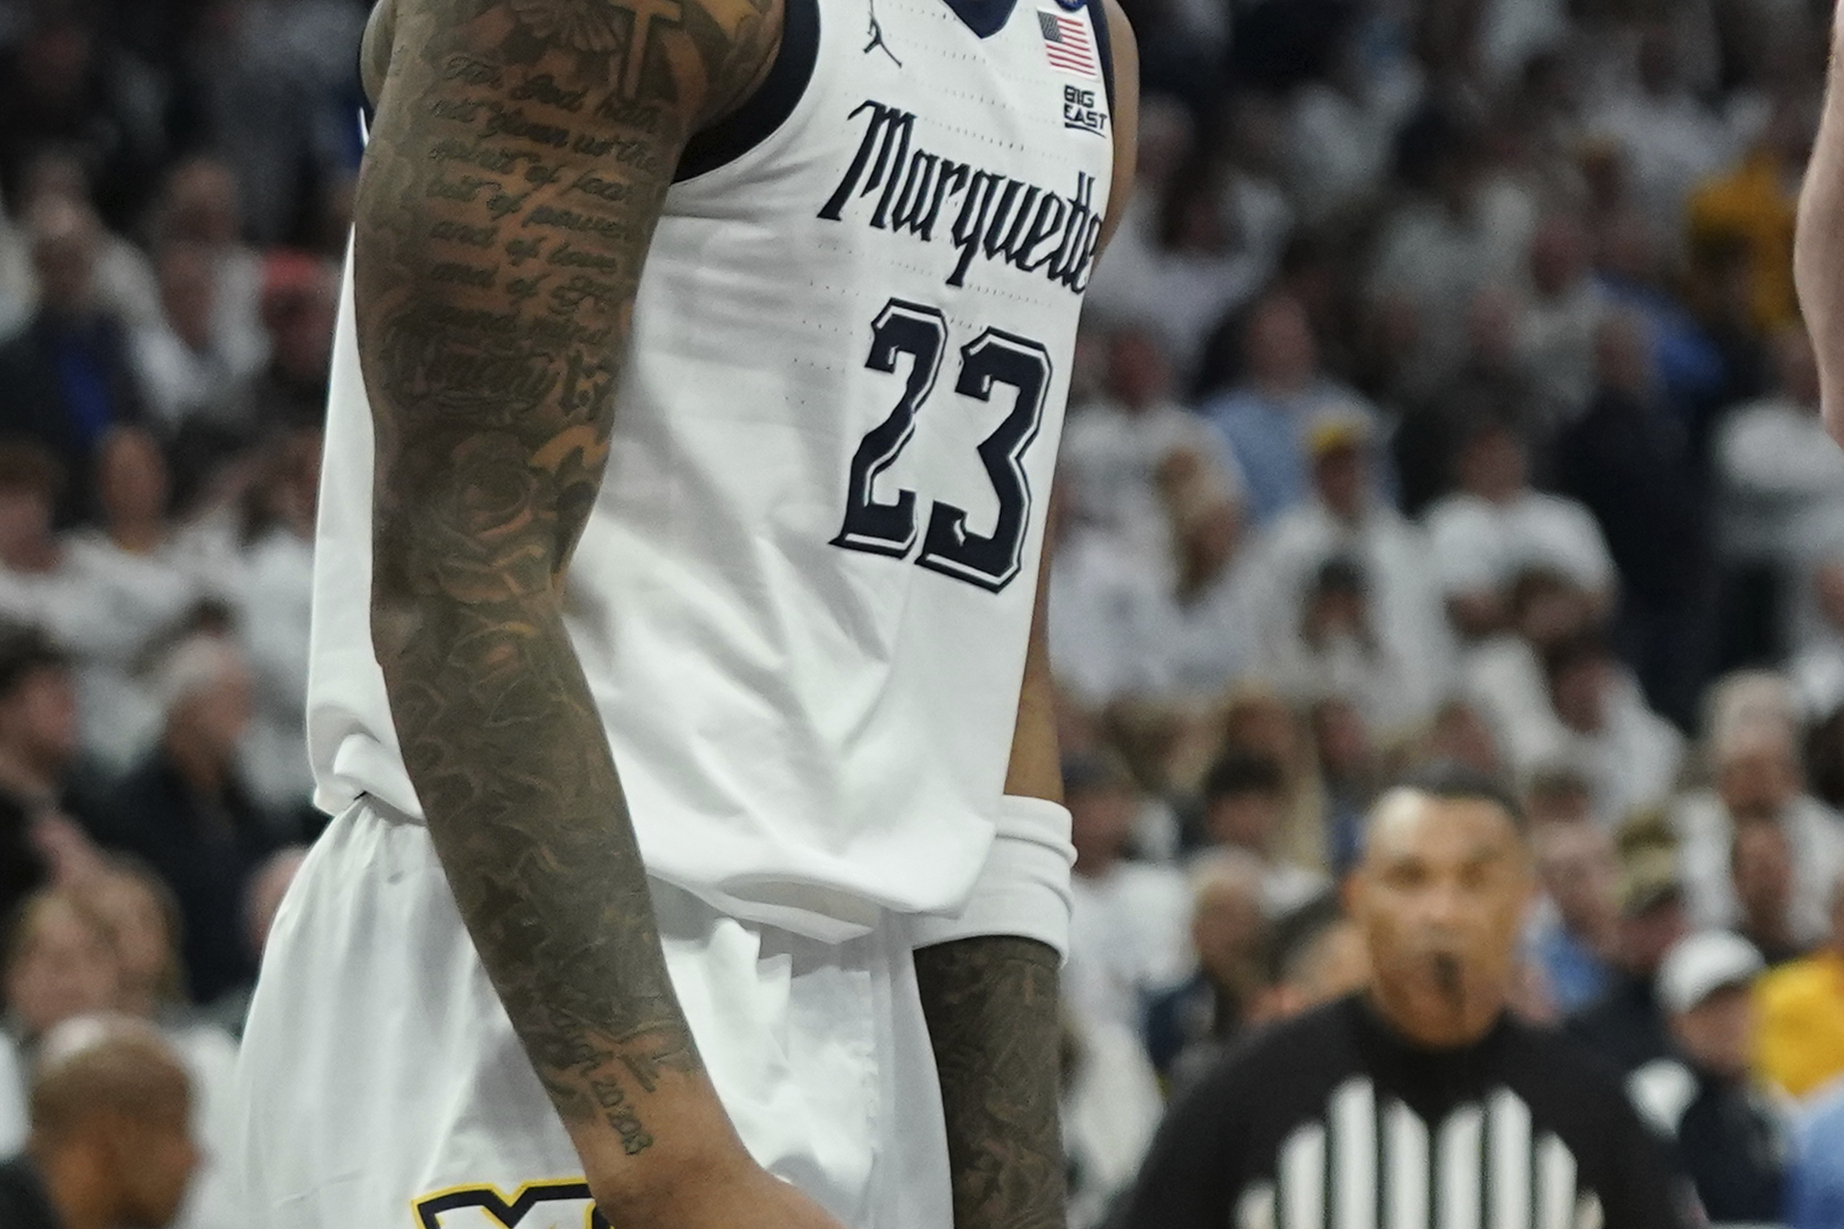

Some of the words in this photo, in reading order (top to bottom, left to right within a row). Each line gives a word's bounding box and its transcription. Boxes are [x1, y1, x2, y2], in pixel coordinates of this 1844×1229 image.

[1064, 84, 1095, 109] BIG
[1064, 104, 1108, 130] EAST
[816, 99, 1103, 295] Marquette
[828, 296, 1053, 595] 23
